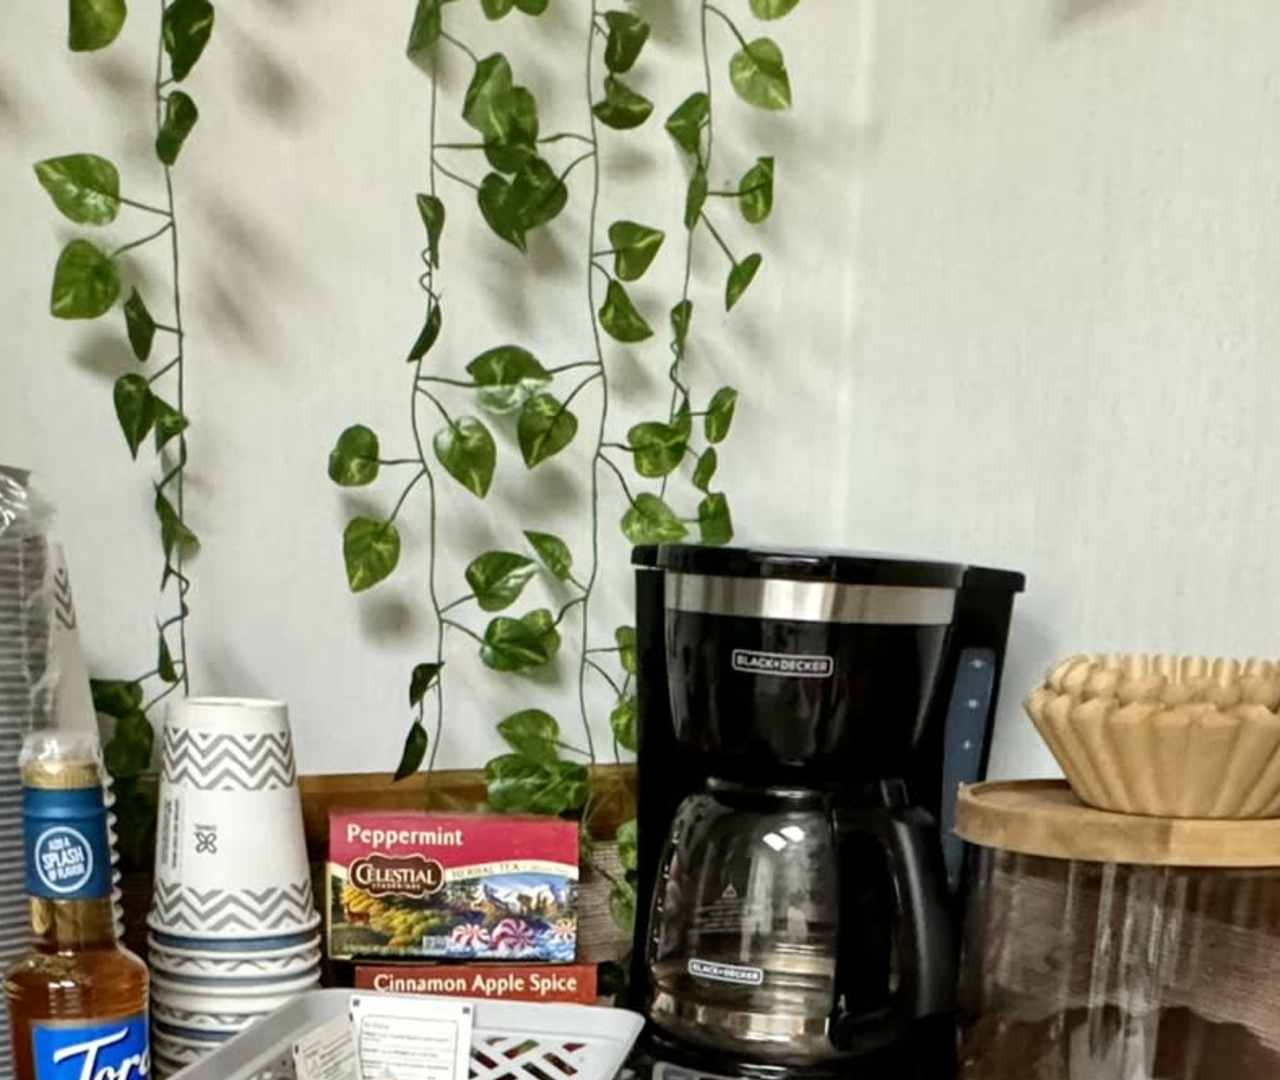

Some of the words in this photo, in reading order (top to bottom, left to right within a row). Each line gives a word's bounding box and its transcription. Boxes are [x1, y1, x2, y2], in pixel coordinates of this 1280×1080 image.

[347, 823, 463, 849] Peppermint
[41, 845, 85, 871] SPLASH
[356, 863, 437, 885] CELESTIAL
[373, 974, 467, 992] Cinnamon
[471, 973, 524, 996] Apple
[529, 973, 578, 996] Spice
